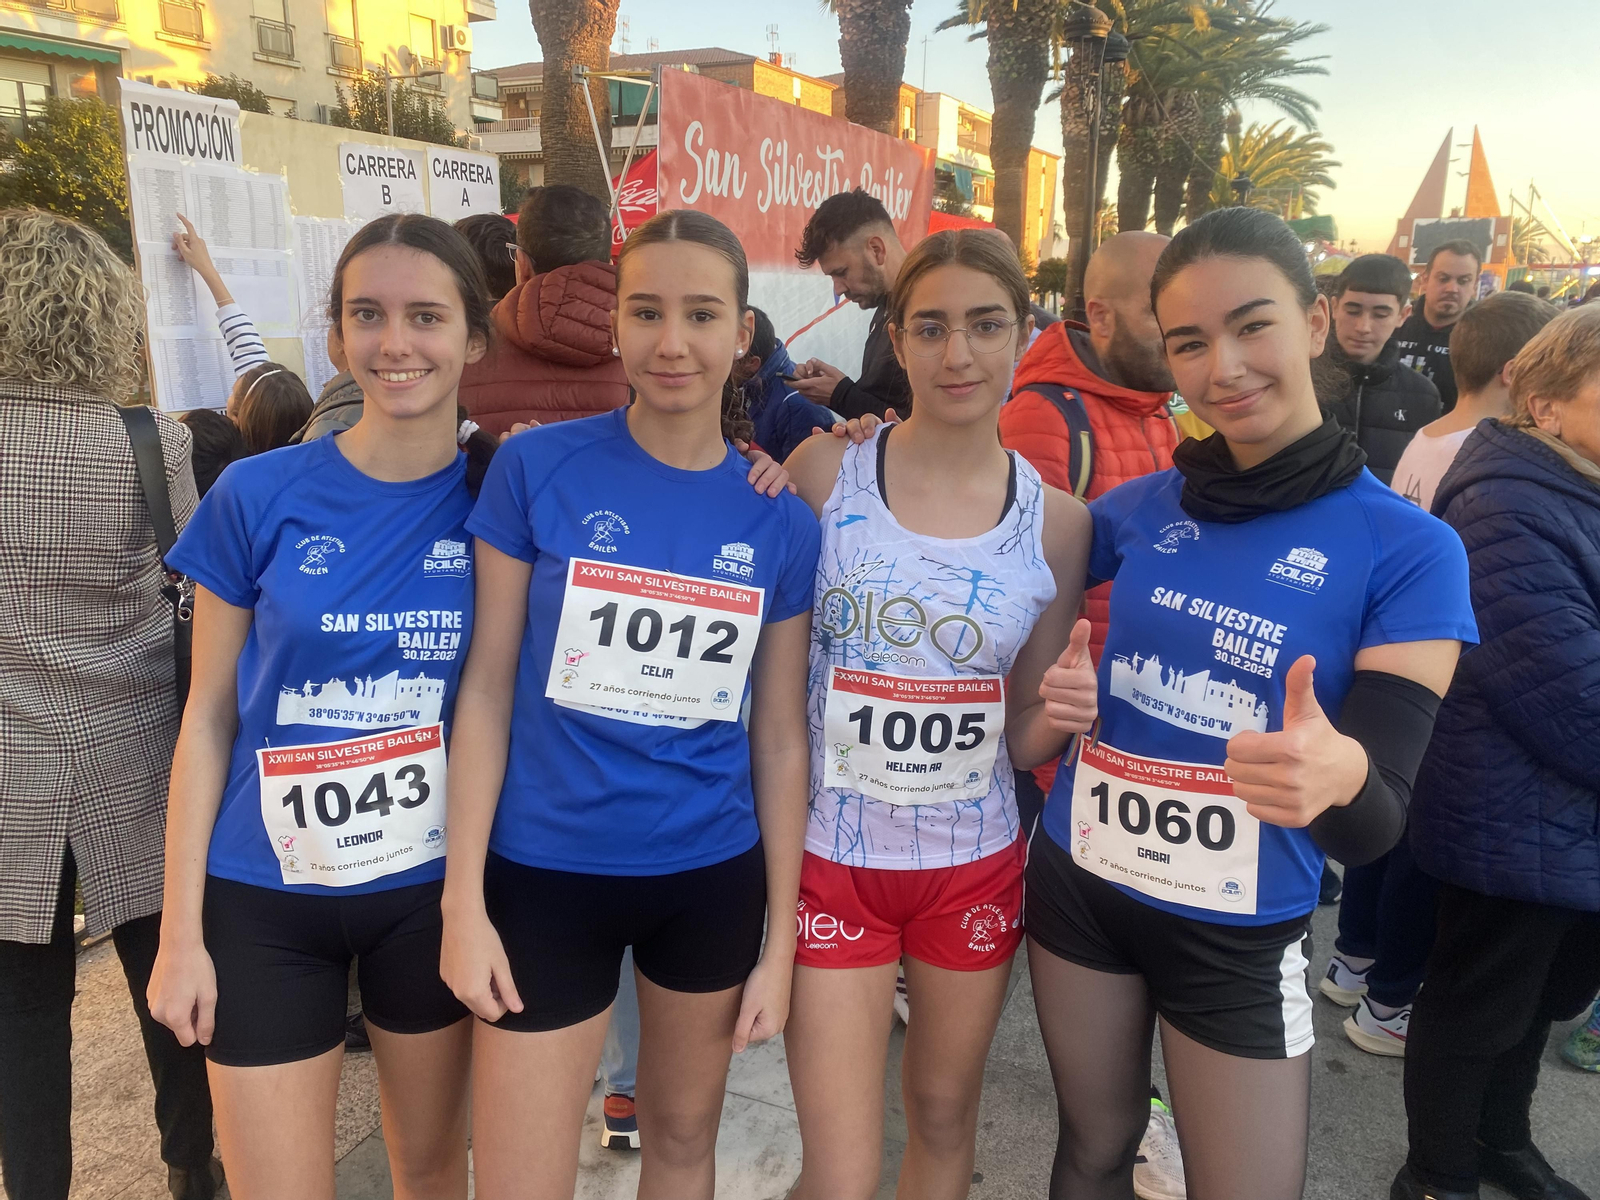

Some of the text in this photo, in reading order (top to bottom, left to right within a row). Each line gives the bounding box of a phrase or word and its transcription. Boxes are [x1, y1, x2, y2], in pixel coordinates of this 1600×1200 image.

[130, 102, 235, 162] PROMOCIÓN
[346, 153, 417, 180] CARRERA
[433, 157, 494, 185] CARRERA
[680, 121, 747, 204] San
[381, 184, 392, 205] B
[461, 187, 471, 207] A
[581, 513, 595, 525] CLUB
[295, 537, 310, 549] CLUB
[579, 566, 751, 603] XXVII SAN SILVESTRE BAILÉN
[320, 610, 463, 632] SAN SILVESTRE
[1150, 587, 1288, 645] SAN SILVESTRE
[398, 632, 461, 649] BAILEN
[589, 601, 739, 664] 1012
[402, 650, 457, 661] 30.12.2023
[863, 648, 926, 667] telecom
[1212, 628, 1280, 667] BAILEN
[641, 664, 674, 679] CELIA
[1214, 649, 1273, 679] 30.12.2023
[839, 671, 994, 693] XXVII SAN SILVESTRE BAILÉN
[603, 685, 625, 694] años
[627, 687, 672, 701] corriendo
[672, 693, 701, 704] juntos
[848, 705, 986, 754] 1005
[268, 730, 432, 765] XXVII SAN SILVESTRE BAILÉN
[886, 760, 943, 774] HELENA AR
[1086, 743, 1105, 760] XXVII
[1106, 753, 1125, 768] SAN
[1127, 762, 1192, 780] SILVESTRE
[858, 772, 868, 781] 27
[869, 777, 888, 789] años
[890, 783, 929, 793] corriendo
[281, 764, 431, 829] 1043
[1089, 781, 1236, 853] 1060
[336, 830, 384, 849] LEONOR
[338, 856, 384, 871] corriendo
[386, 845, 414, 862] juntos
[1137, 847, 1171, 864] GABRI
[1099, 857, 1108, 866] 27
[1110, 862, 1128, 874] años
[1130, 869, 1173, 886] corriendo
[1174, 880, 1206, 893] juntos
[960, 911, 972, 929] CLUB
[971, 905, 981, 914] DE
[968, 942, 996, 952] BAILÉN
